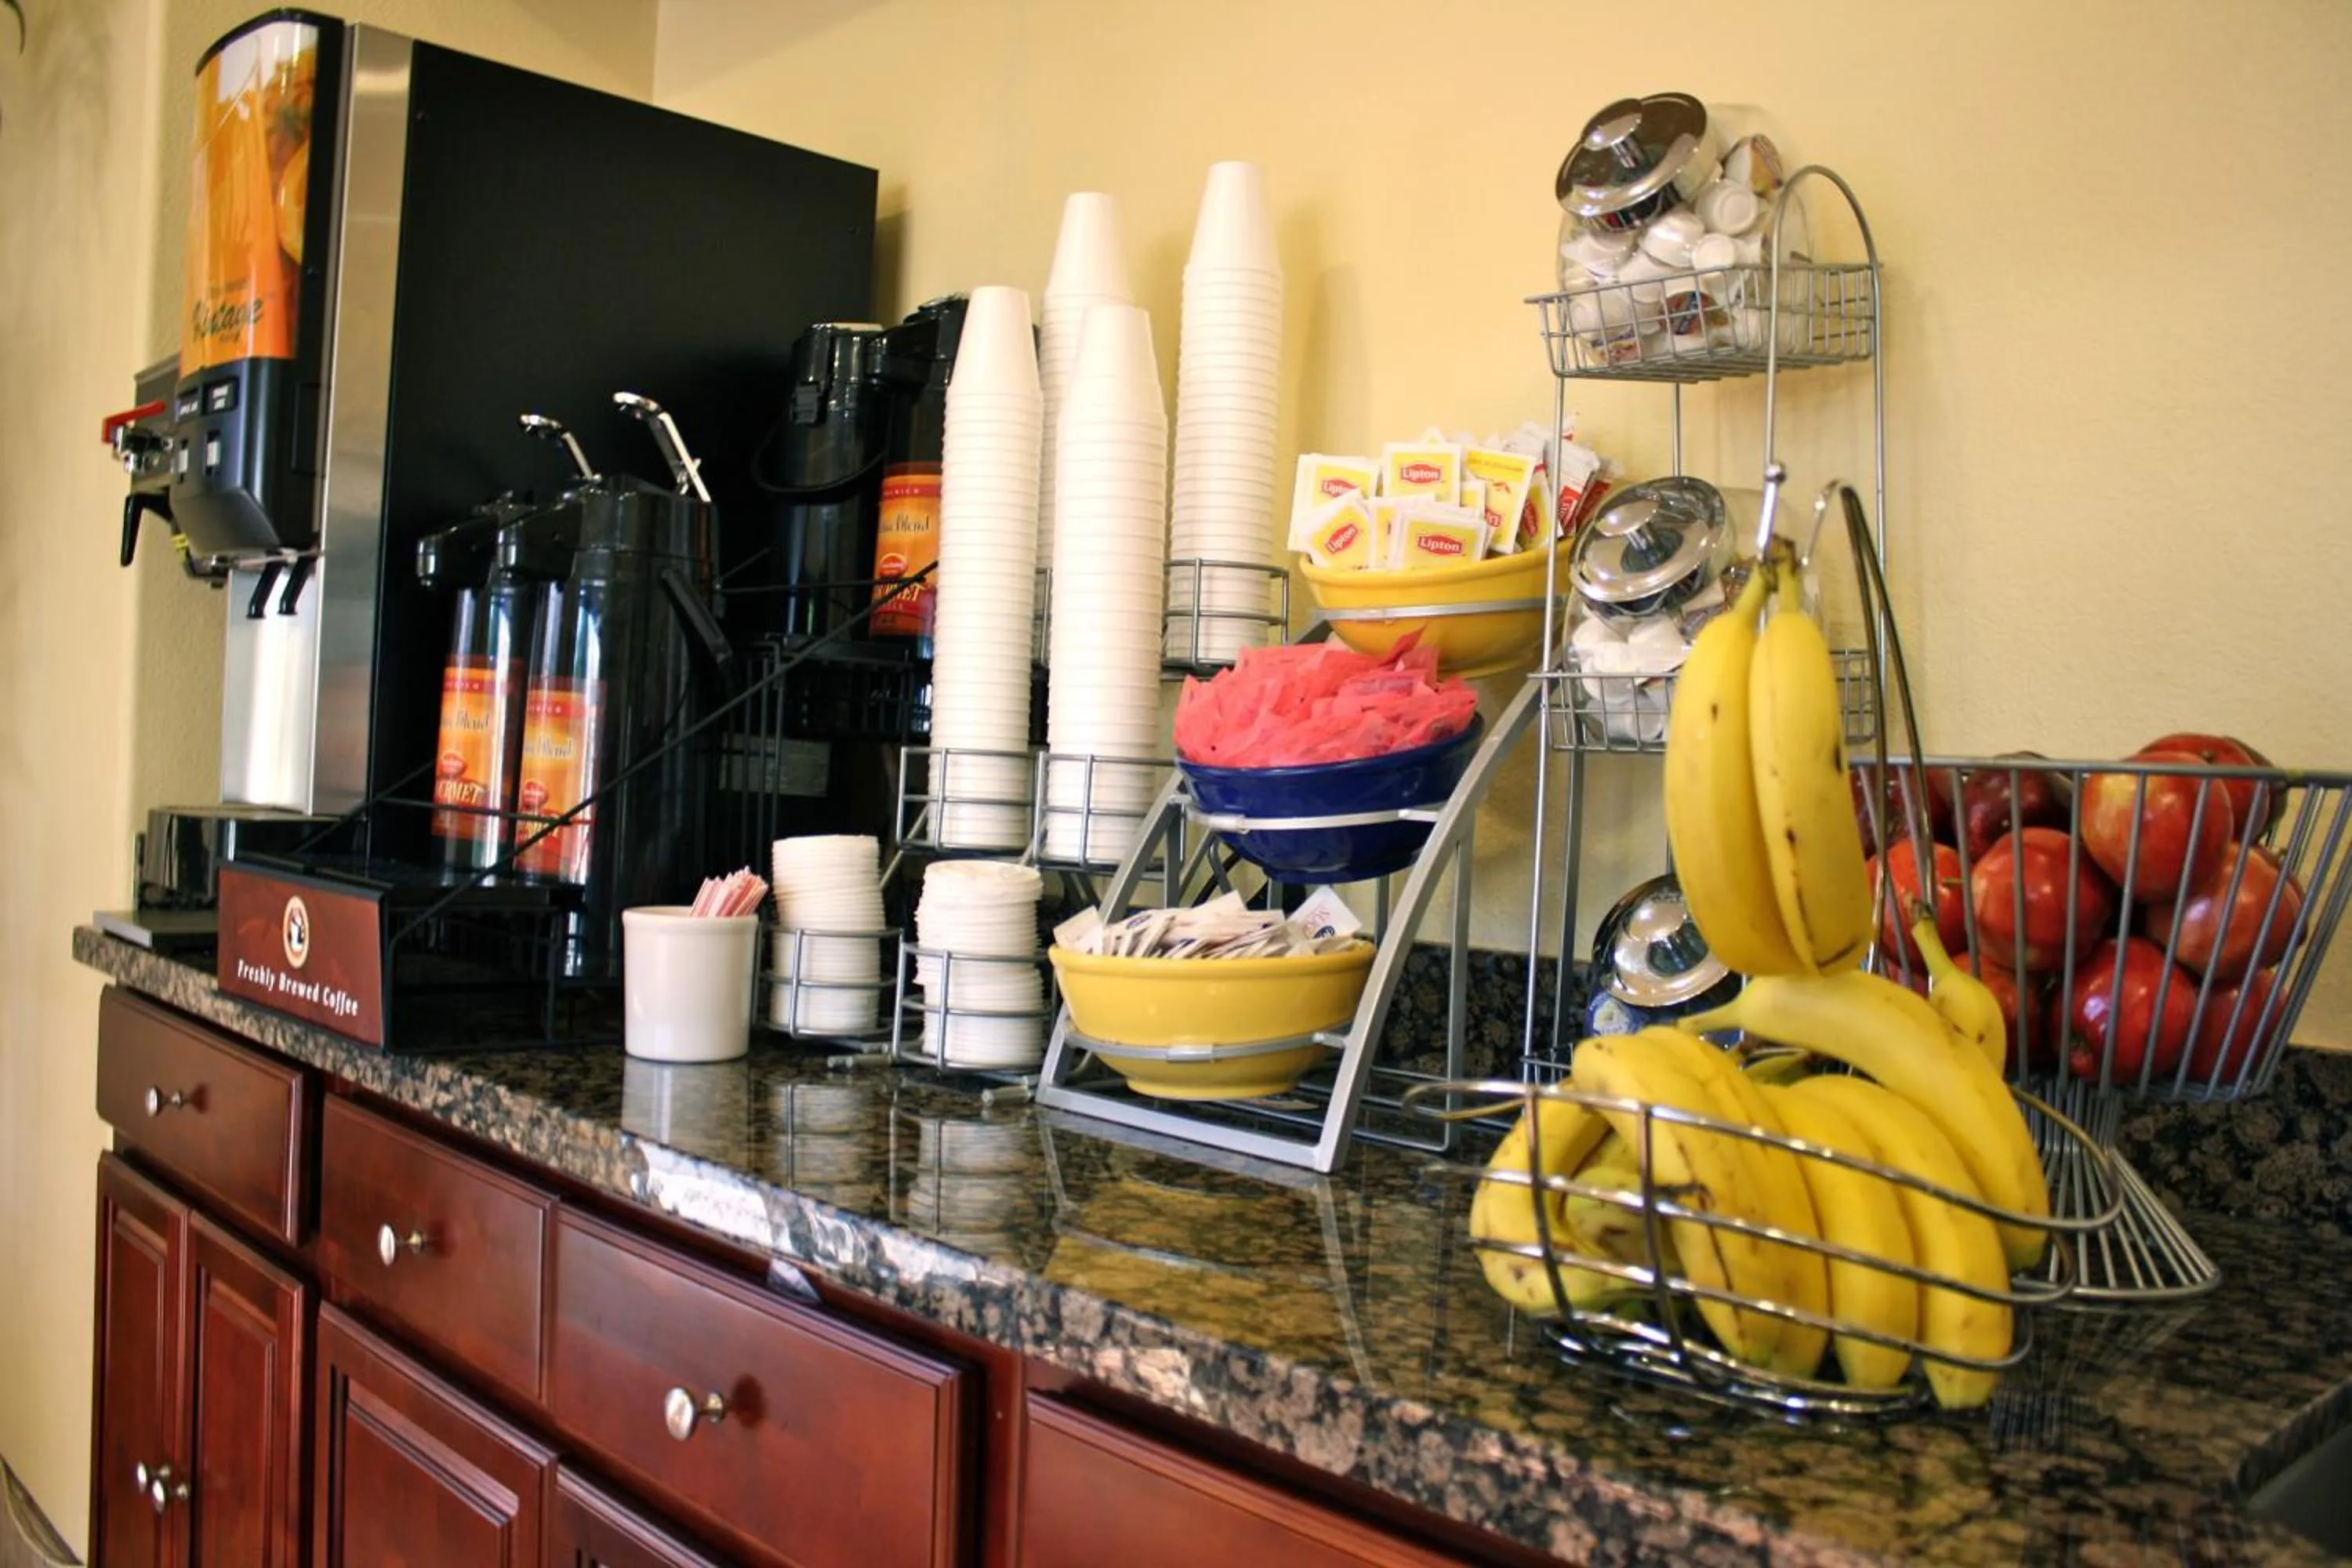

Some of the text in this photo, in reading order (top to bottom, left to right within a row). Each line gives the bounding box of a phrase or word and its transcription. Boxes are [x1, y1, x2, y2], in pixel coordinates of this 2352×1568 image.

[1402, 467, 1440, 481] Lipton
[1327, 526, 1356, 553] Lipton
[1420, 537, 1462, 554] Lipton
[237, 958, 358, 1016] Freshly Brewed Coffee
